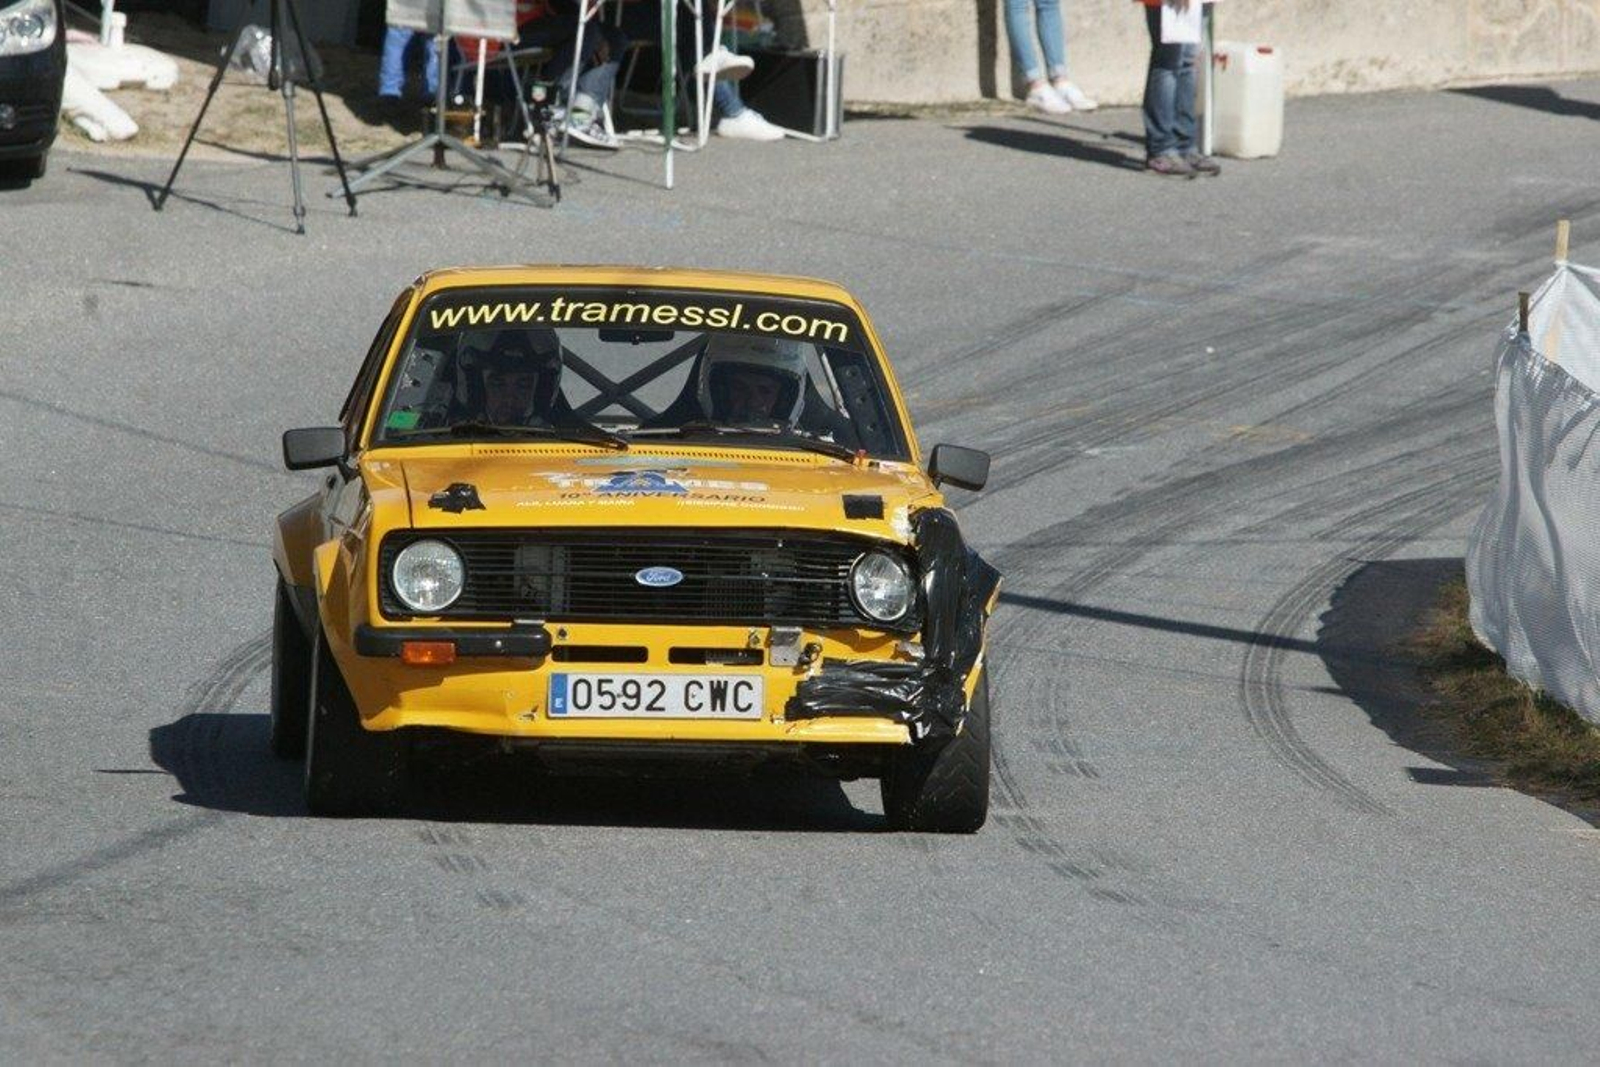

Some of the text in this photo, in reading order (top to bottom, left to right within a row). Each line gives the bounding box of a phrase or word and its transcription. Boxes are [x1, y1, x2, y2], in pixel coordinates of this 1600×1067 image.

[430, 296, 848, 343] www.tramessl.com
[572, 678, 753, 713] 0592 CWC
